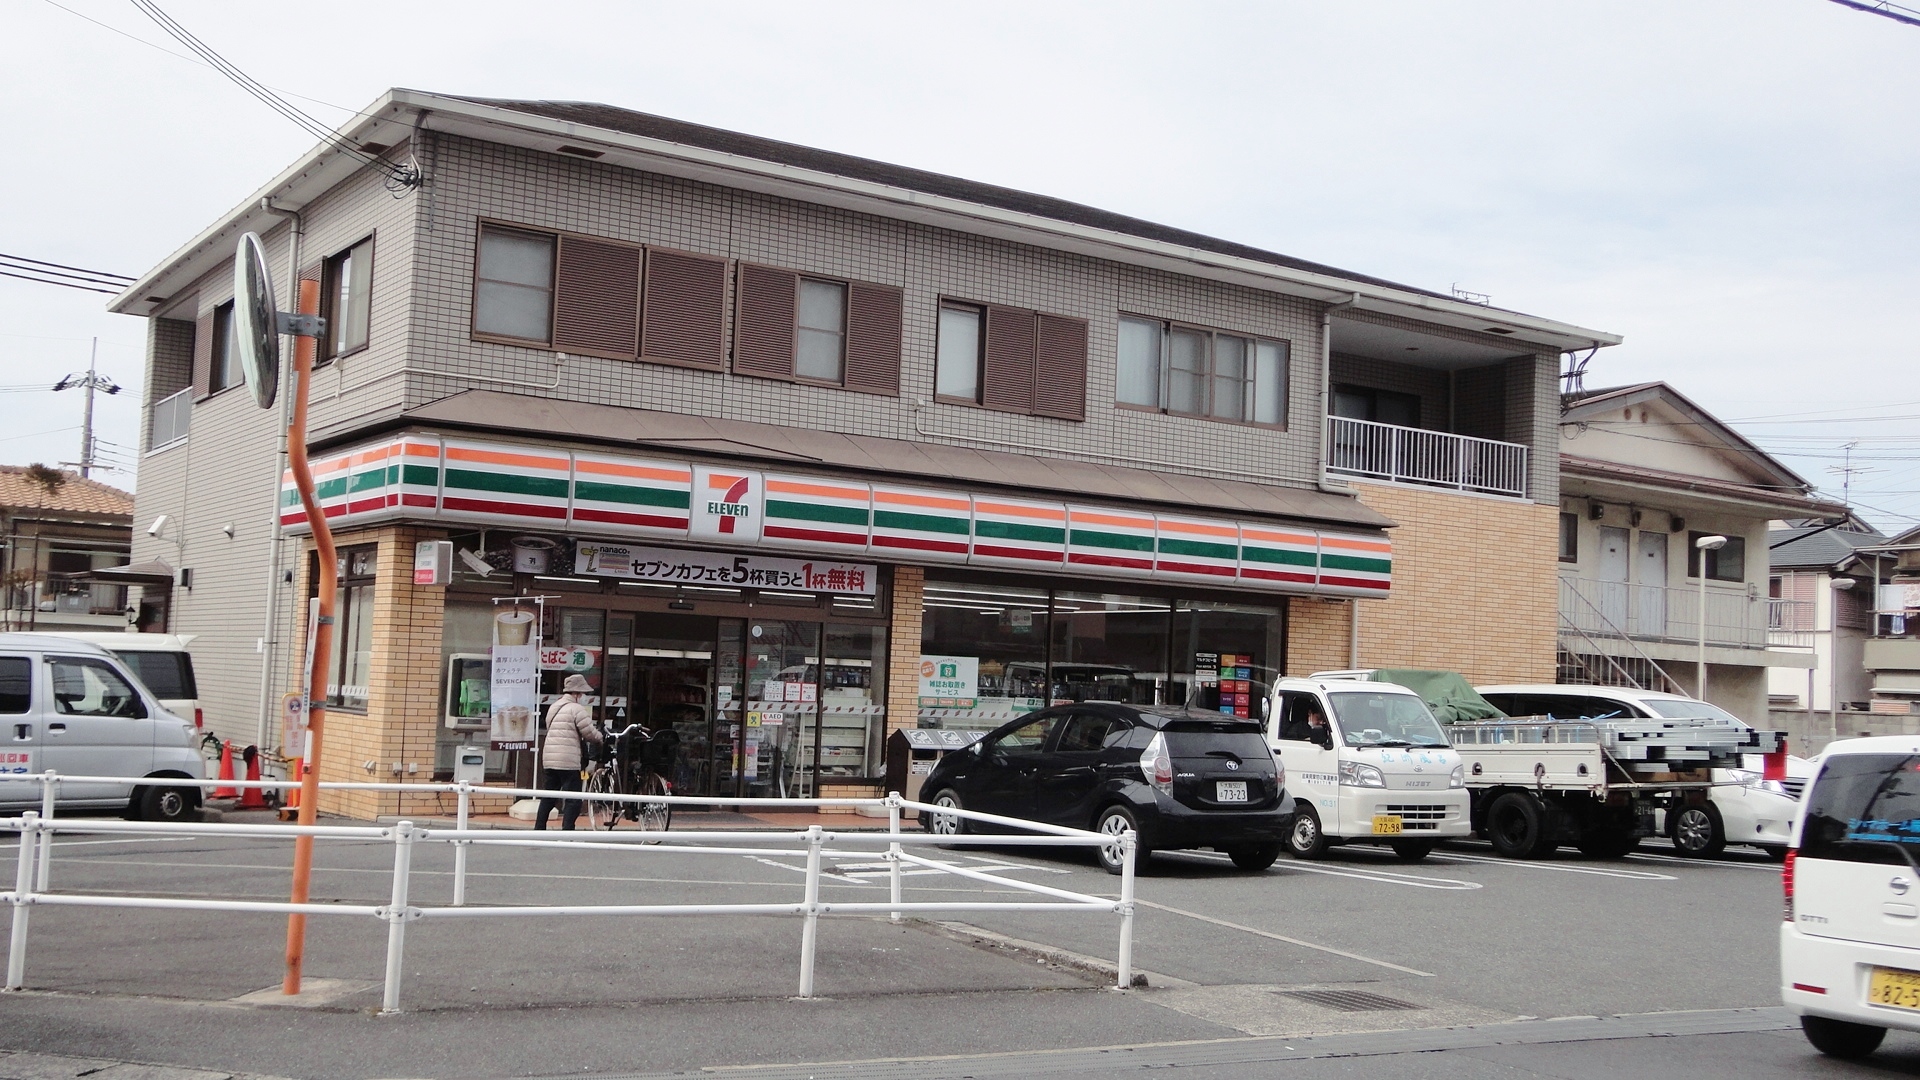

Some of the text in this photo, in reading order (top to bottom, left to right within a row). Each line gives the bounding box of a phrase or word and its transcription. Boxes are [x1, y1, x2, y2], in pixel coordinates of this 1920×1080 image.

[600, 546, 627, 555] nanaco
[631, 557, 866, 592] セブンカフェを5杯買うと1杯無料
[495, 656, 530, 664] 濃厚ミルクの
[573, 651, 586, 665] 酒
[516, 677, 531, 685] CAFÉ
[929, 680, 966, 689] 雑誌お取置き
[1224, 789, 1246, 800] 73-23
[1378, 823, 1400, 833] 72-98
